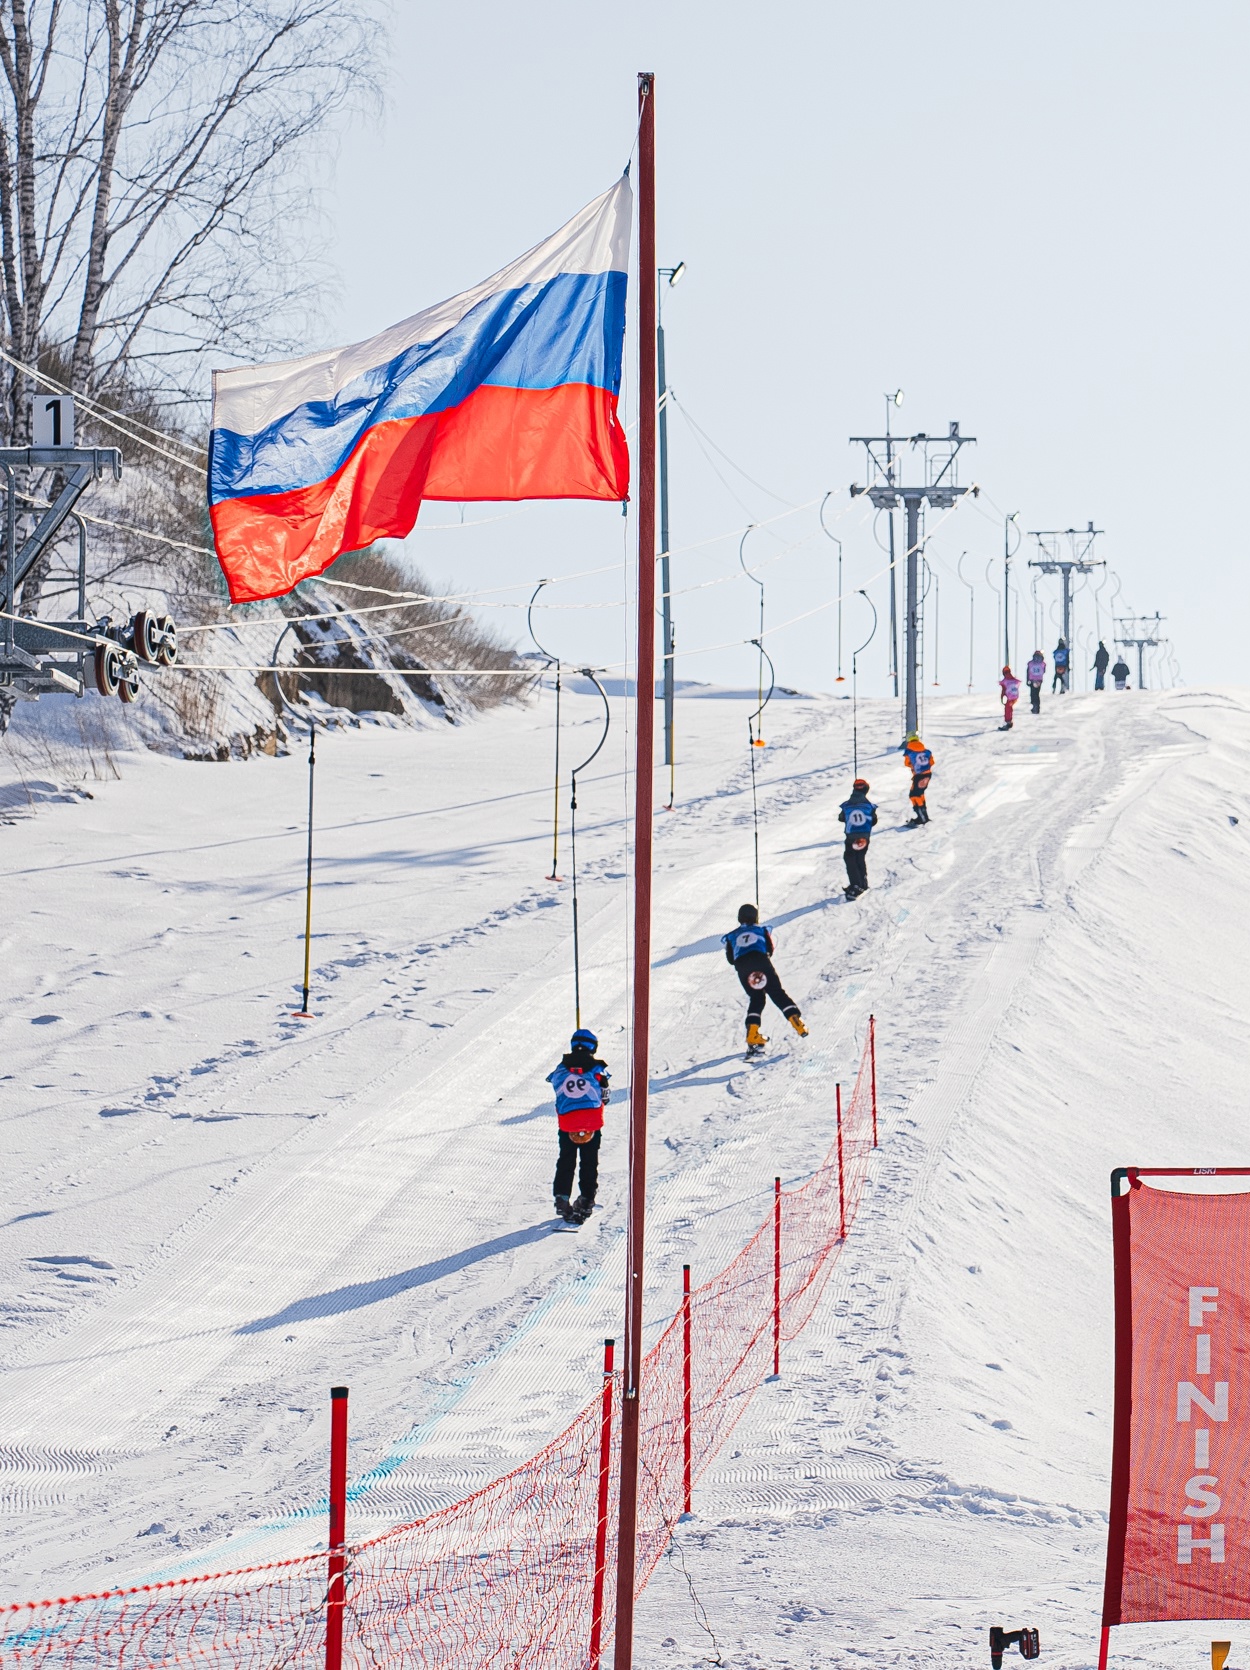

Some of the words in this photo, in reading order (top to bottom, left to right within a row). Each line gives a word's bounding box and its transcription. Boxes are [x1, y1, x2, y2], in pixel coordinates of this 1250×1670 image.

[45, 399, 61, 446] 1
[952, 422, 958, 436] 2
[742, 934, 750, 943] 7
[1193, 1167, 1216, 1175] LISKI
[1176, 1286, 1229, 1565] FINISH
